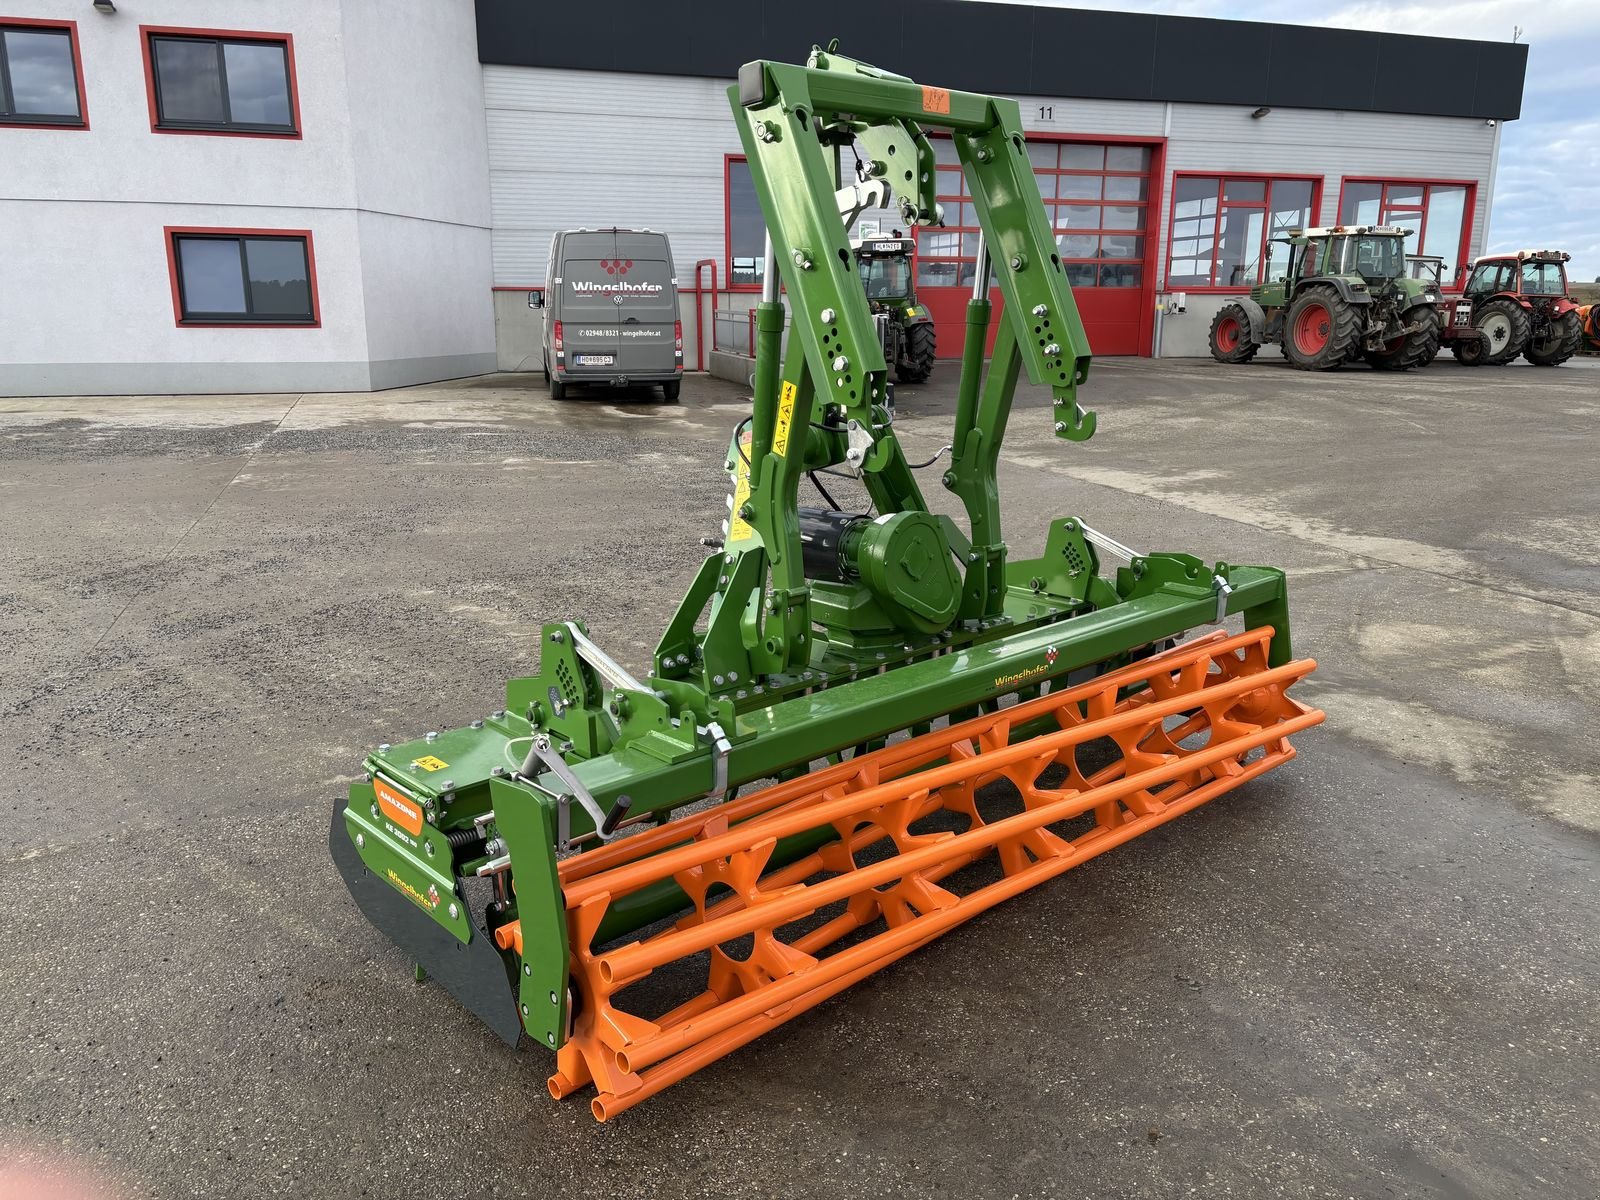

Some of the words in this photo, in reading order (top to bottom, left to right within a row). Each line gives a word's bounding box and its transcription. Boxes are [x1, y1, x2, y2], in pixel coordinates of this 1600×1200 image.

[1039, 106, 1052, 119] 11
[572, 281, 663, 296] Wingelhofer
[622, 330, 661, 338] wingelhofer.at
[994, 664, 1049, 687] Wingelhofer
[380, 789, 417, 821] AMAZONE
